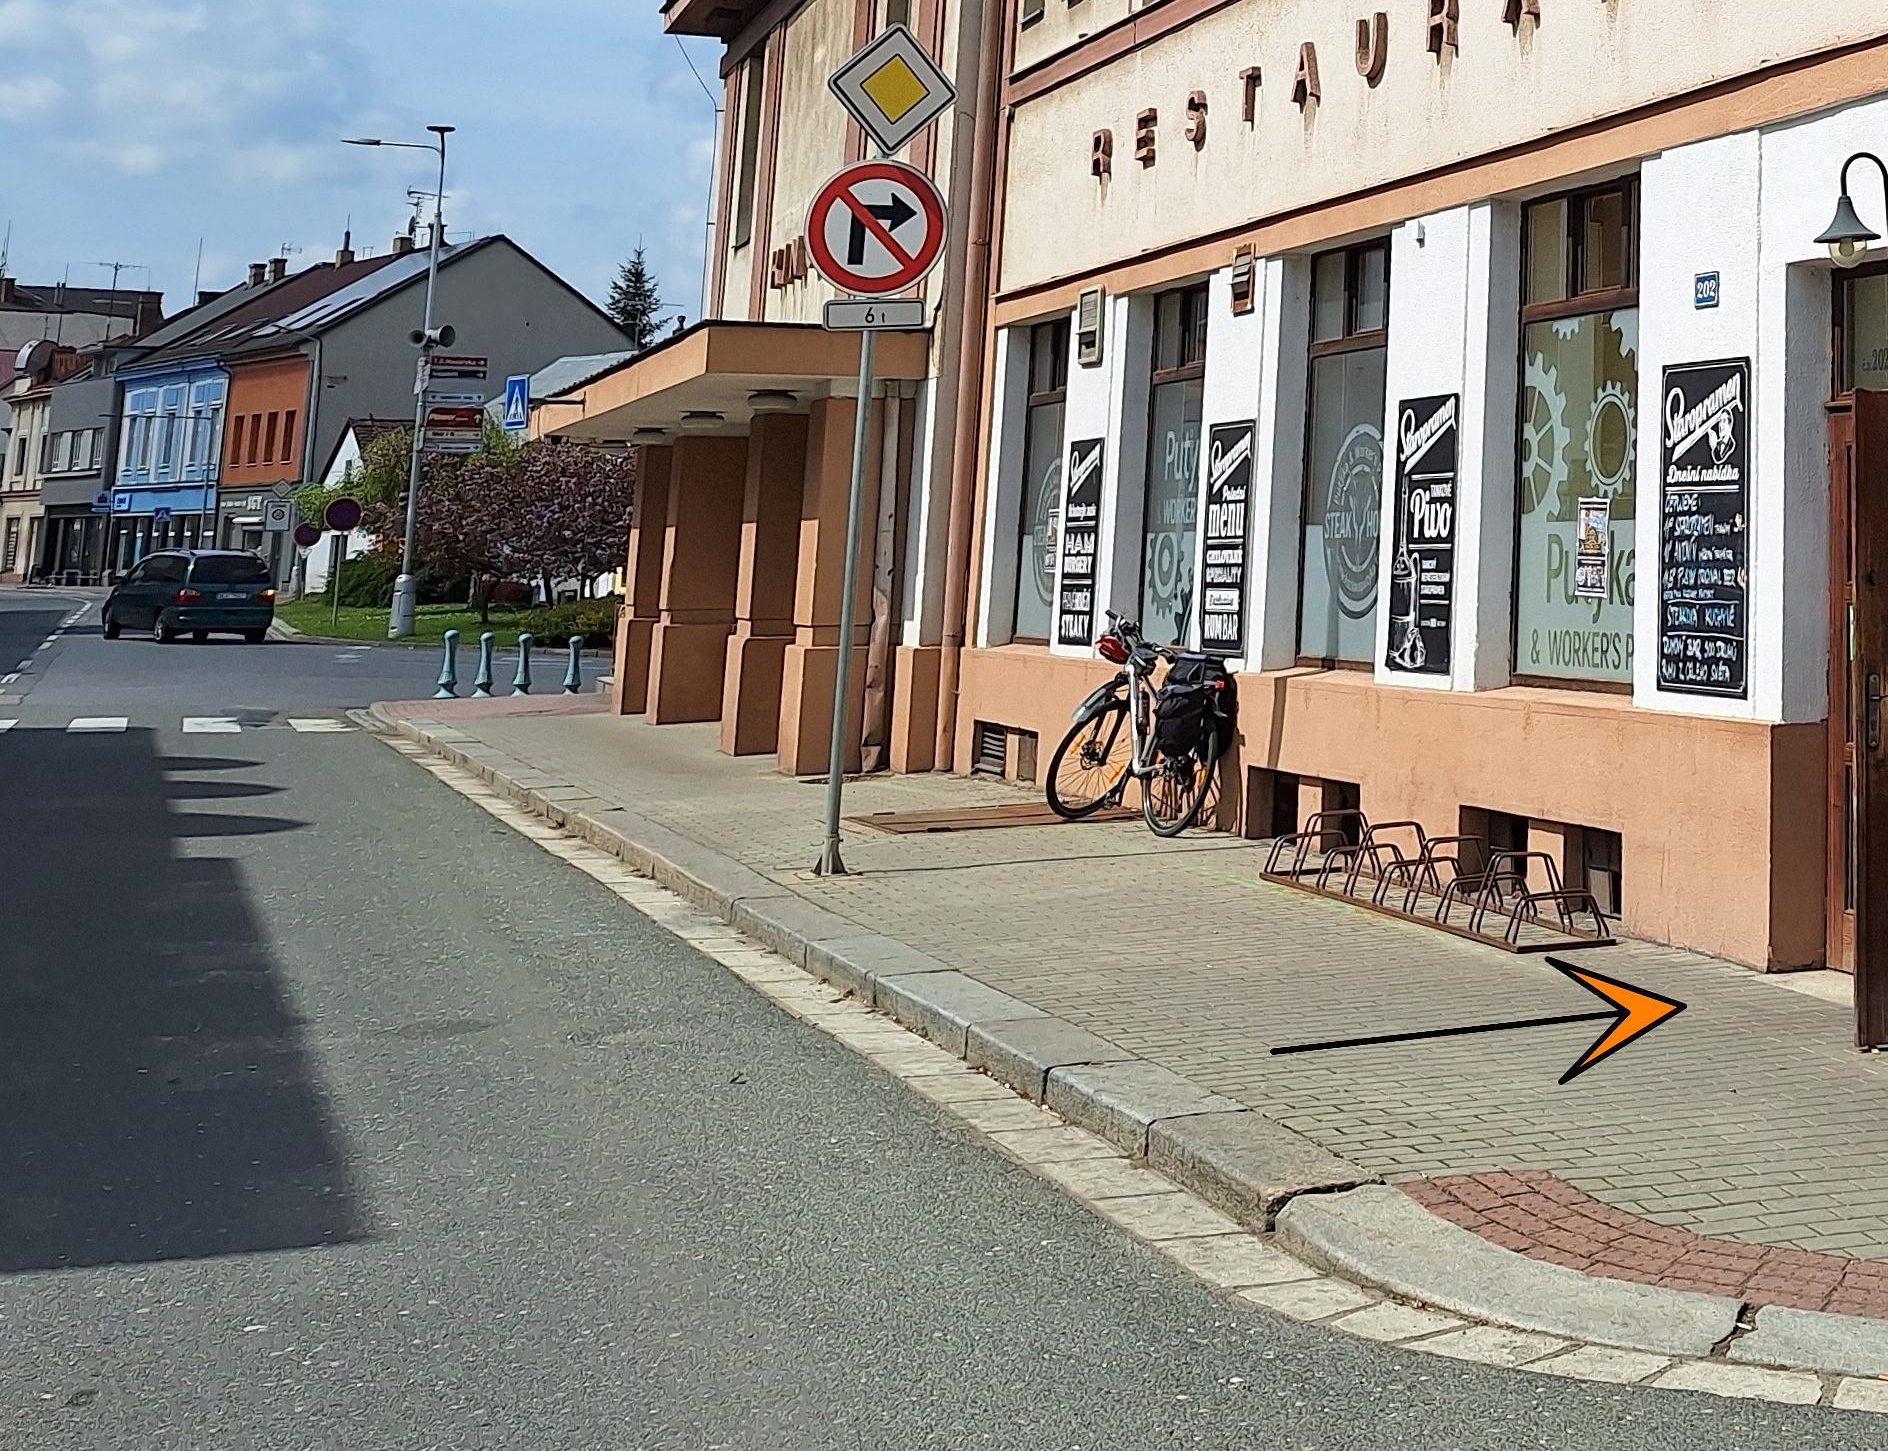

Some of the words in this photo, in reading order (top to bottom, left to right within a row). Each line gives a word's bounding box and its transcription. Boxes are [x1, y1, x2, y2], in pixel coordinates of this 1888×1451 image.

[1697, 280, 1716, 298] 202
[864, 307, 875, 324] 6
[1872, 348, 1888, 370] 202
[1208, 503, 1245, 537] menu
[1324, 511, 1352, 539] STEAK
[1410, 488, 1452, 538] Pivo
[1065, 532, 1095, 554] HAM
[1531, 629, 1540, 664] &
[1548, 629, 1622, 669] WORKER'S
